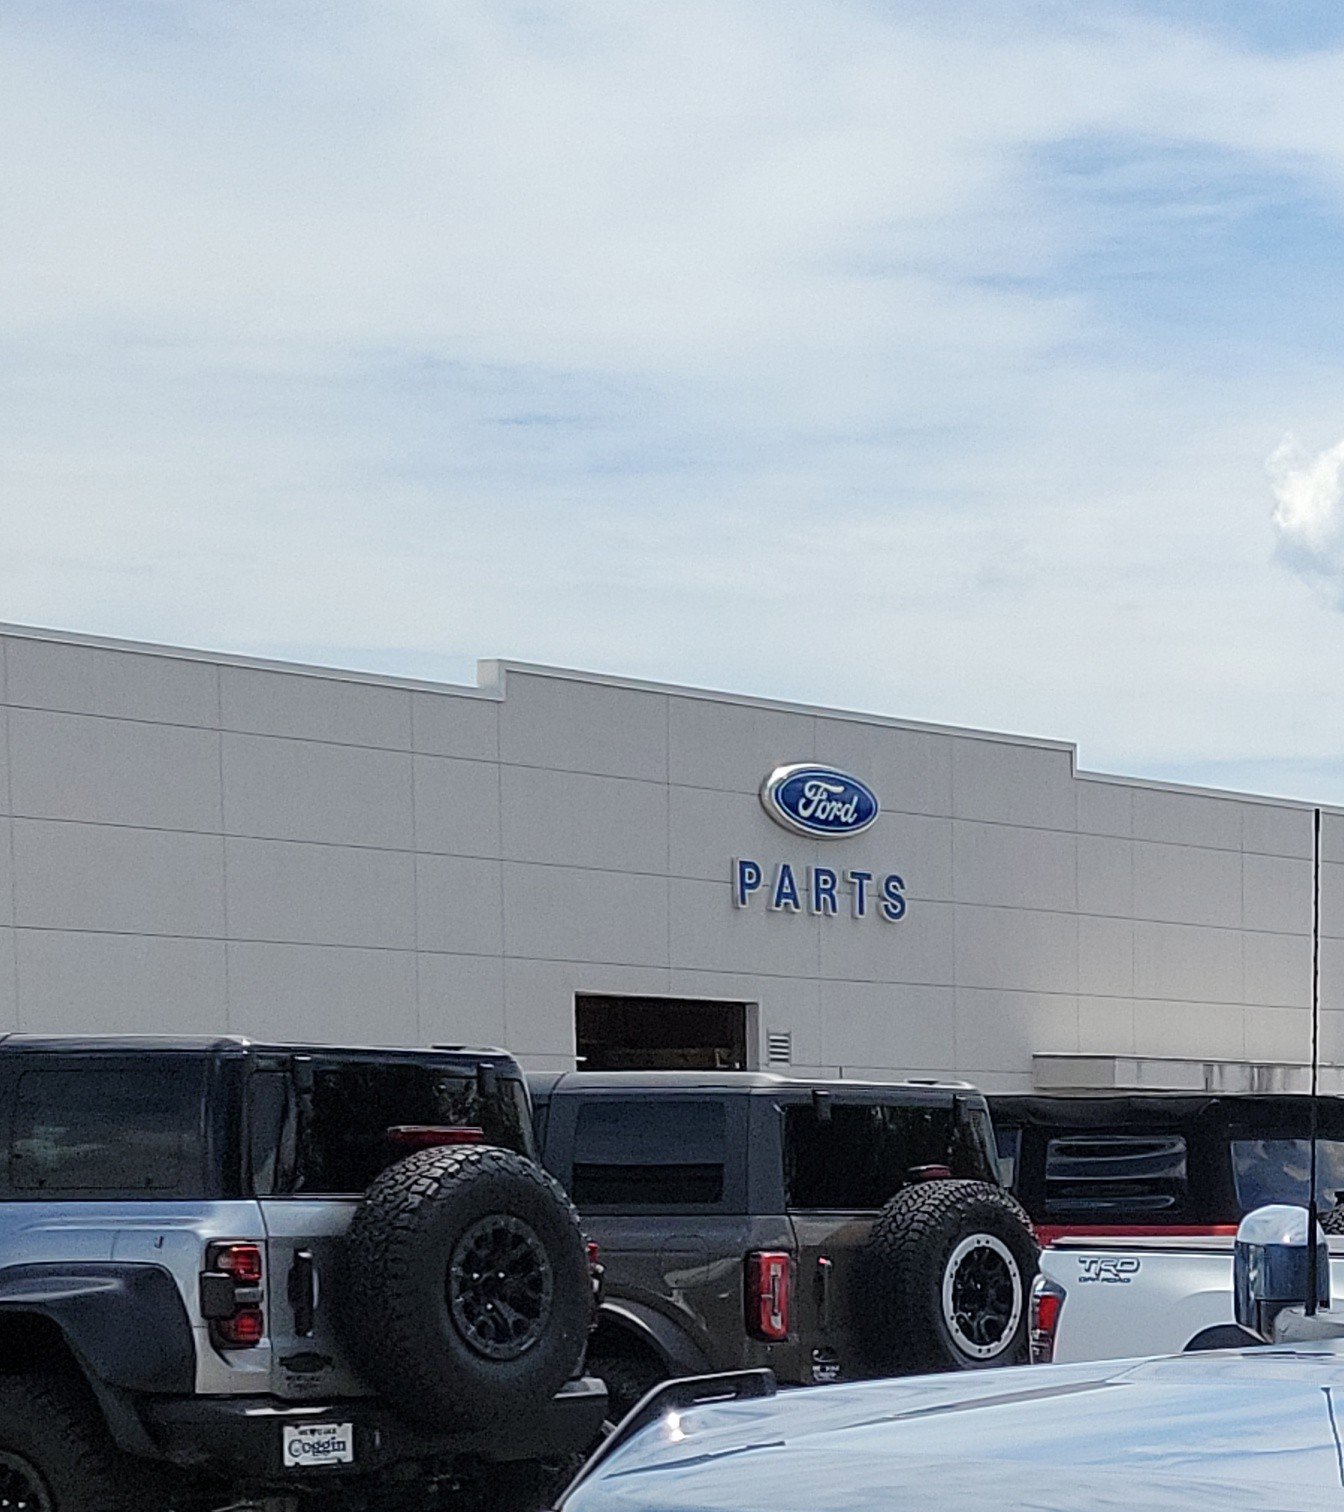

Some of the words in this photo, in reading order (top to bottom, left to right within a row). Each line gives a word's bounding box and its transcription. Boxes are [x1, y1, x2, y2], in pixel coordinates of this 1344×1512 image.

[798, 779, 859, 823] Ford
[734, 858, 907, 922] PARTS
[1079, 1256, 1140, 1278] TRD
[288, 1437, 346, 1457] Coggin
